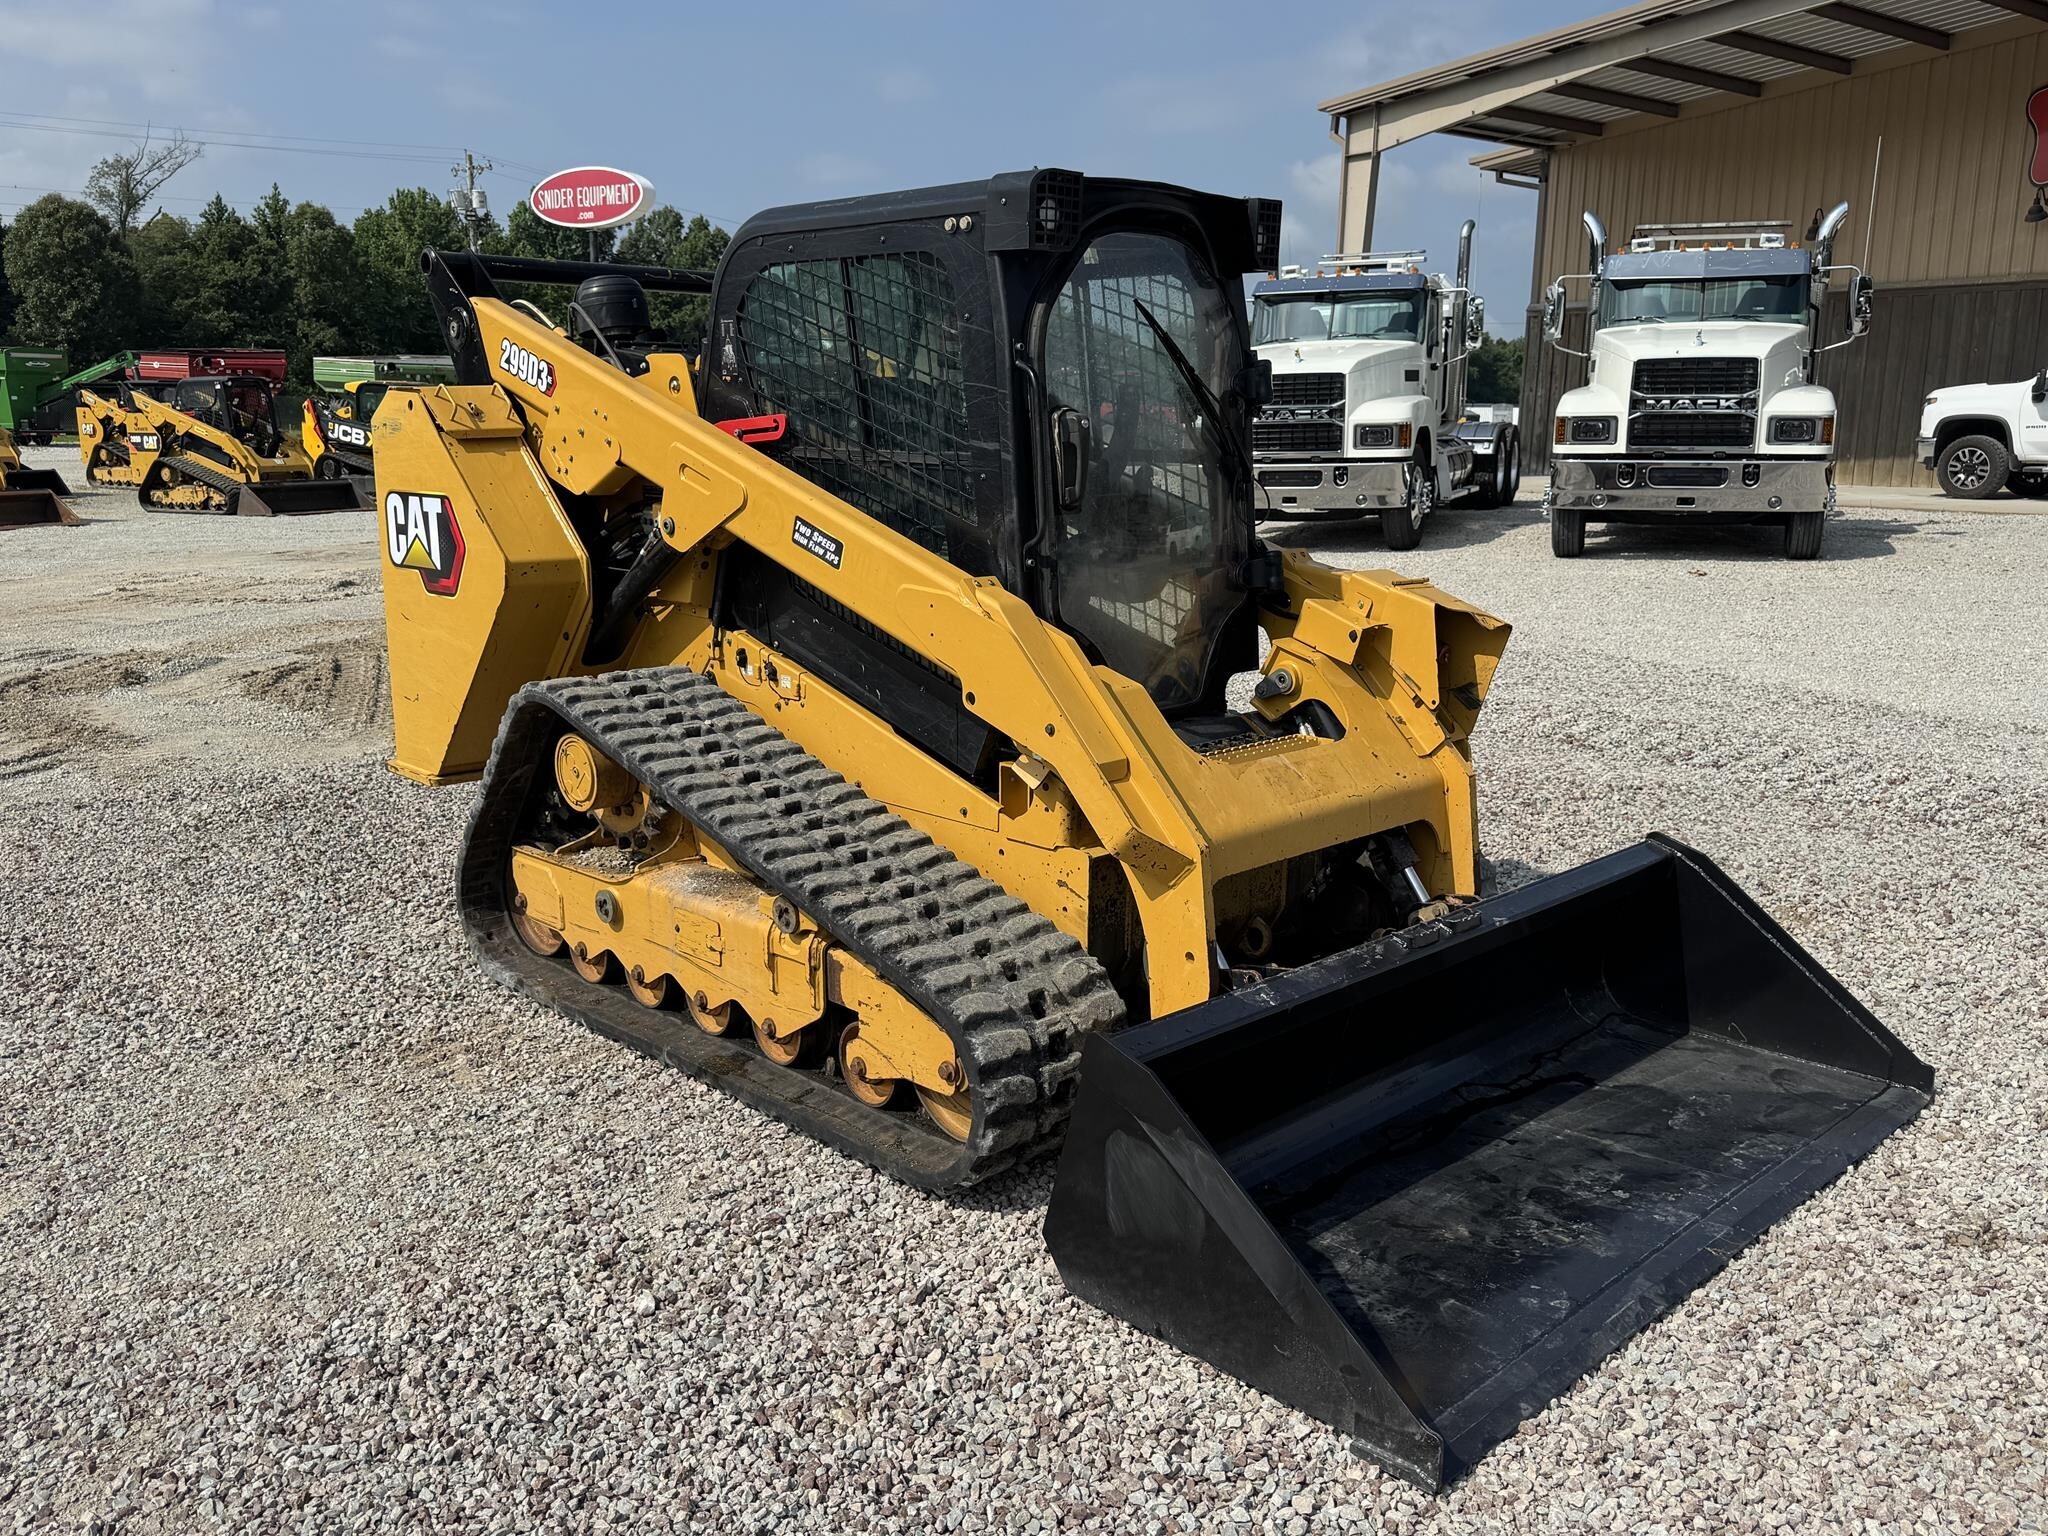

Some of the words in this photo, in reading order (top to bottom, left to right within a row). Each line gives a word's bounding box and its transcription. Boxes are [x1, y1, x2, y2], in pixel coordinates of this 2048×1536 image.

[538, 188, 574, 210] SNIDER
[577, 183, 635, 207] EQUIPMENT
[577, 211, 594, 220] .com
[500, 338, 549, 393] 299D3
[1646, 399, 1740, 410] MACK
[1260, 410, 1330, 420] MACK
[82, 423, 94, 435] CAT
[328, 423, 365, 446] JCB
[143, 435, 158, 450] CAT
[386, 492, 443, 571] CAT
[825, 550, 839, 565] XPS
